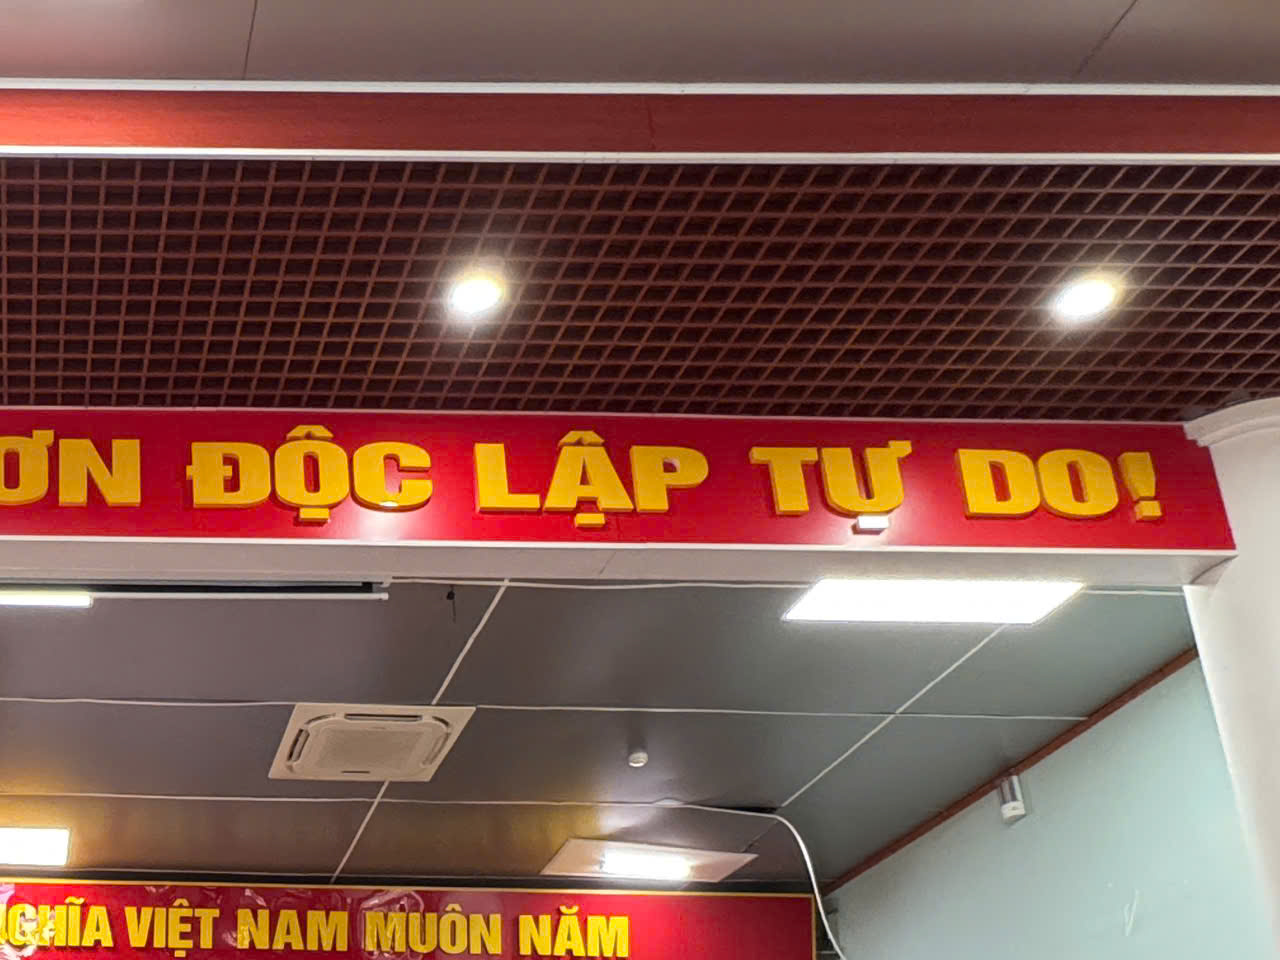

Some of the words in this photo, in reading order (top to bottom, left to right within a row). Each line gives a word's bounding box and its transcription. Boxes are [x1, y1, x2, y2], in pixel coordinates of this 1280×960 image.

[186, 424, 433, 525] ĐỘC
[475, 430, 709, 529] LẬP
[749, 439, 914, 532] TỰ
[960, 449, 1159, 521] DO!
[124, 899, 221, 957] VIỆT
[237, 909, 349, 953] NAM
[363, 903, 503, 956] MUÔN
[518, 904, 630, 959] NĂM
